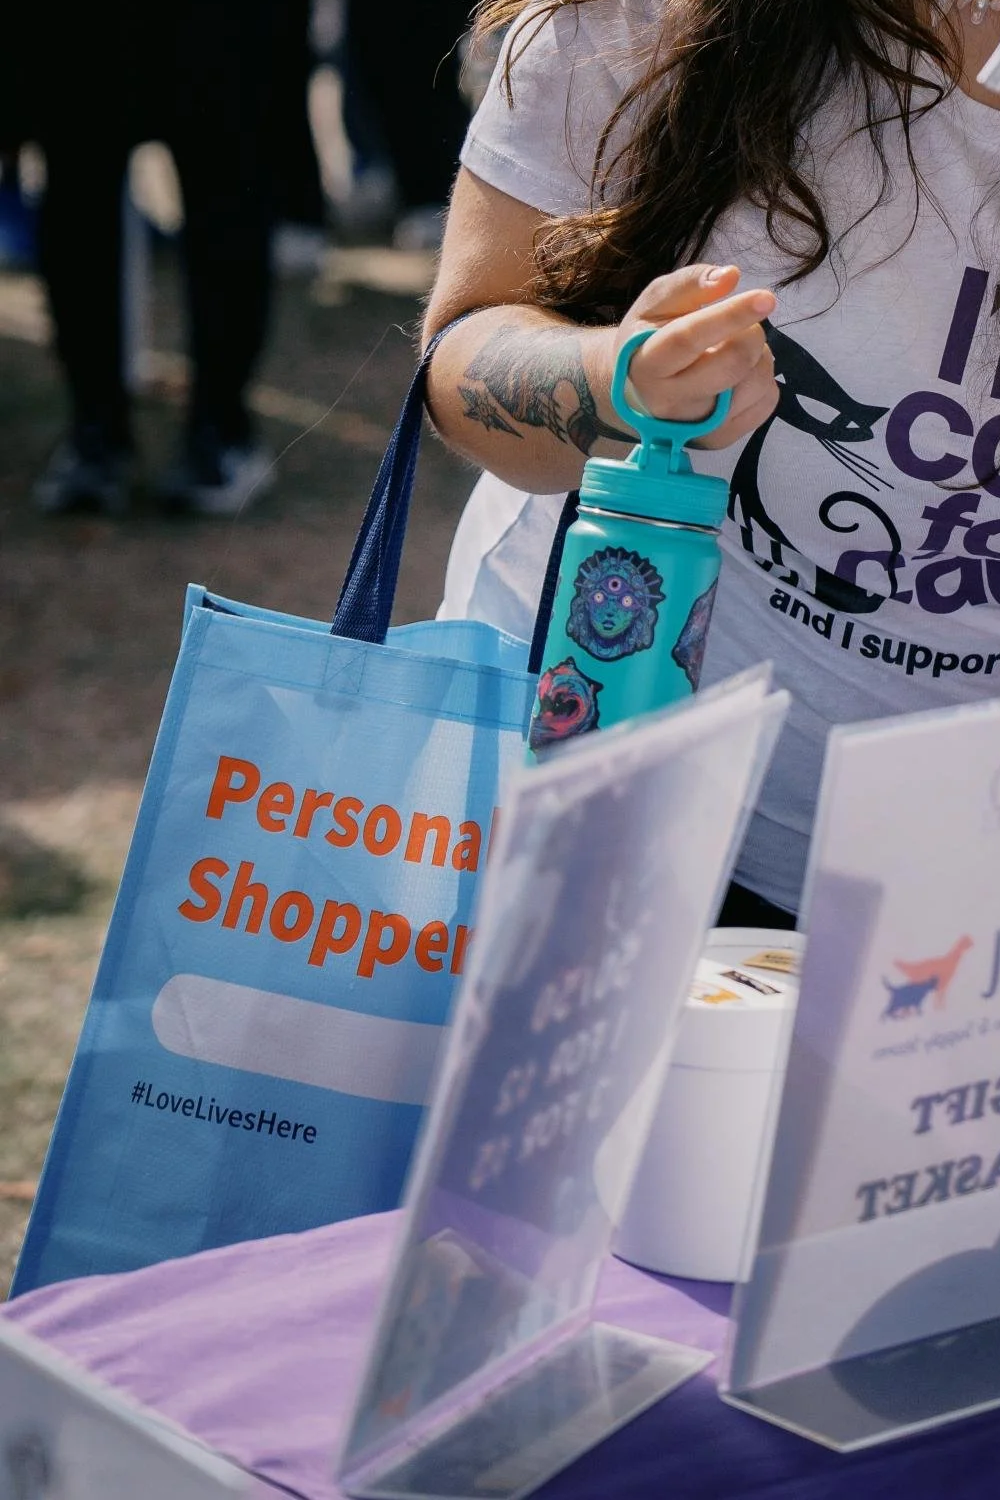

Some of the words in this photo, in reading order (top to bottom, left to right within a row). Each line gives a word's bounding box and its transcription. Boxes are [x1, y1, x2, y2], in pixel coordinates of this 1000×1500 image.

[769, 587, 835, 639] and
[841, 621, 855, 650] I
[131, 1081, 318, 1145] #LoveLivesHere
